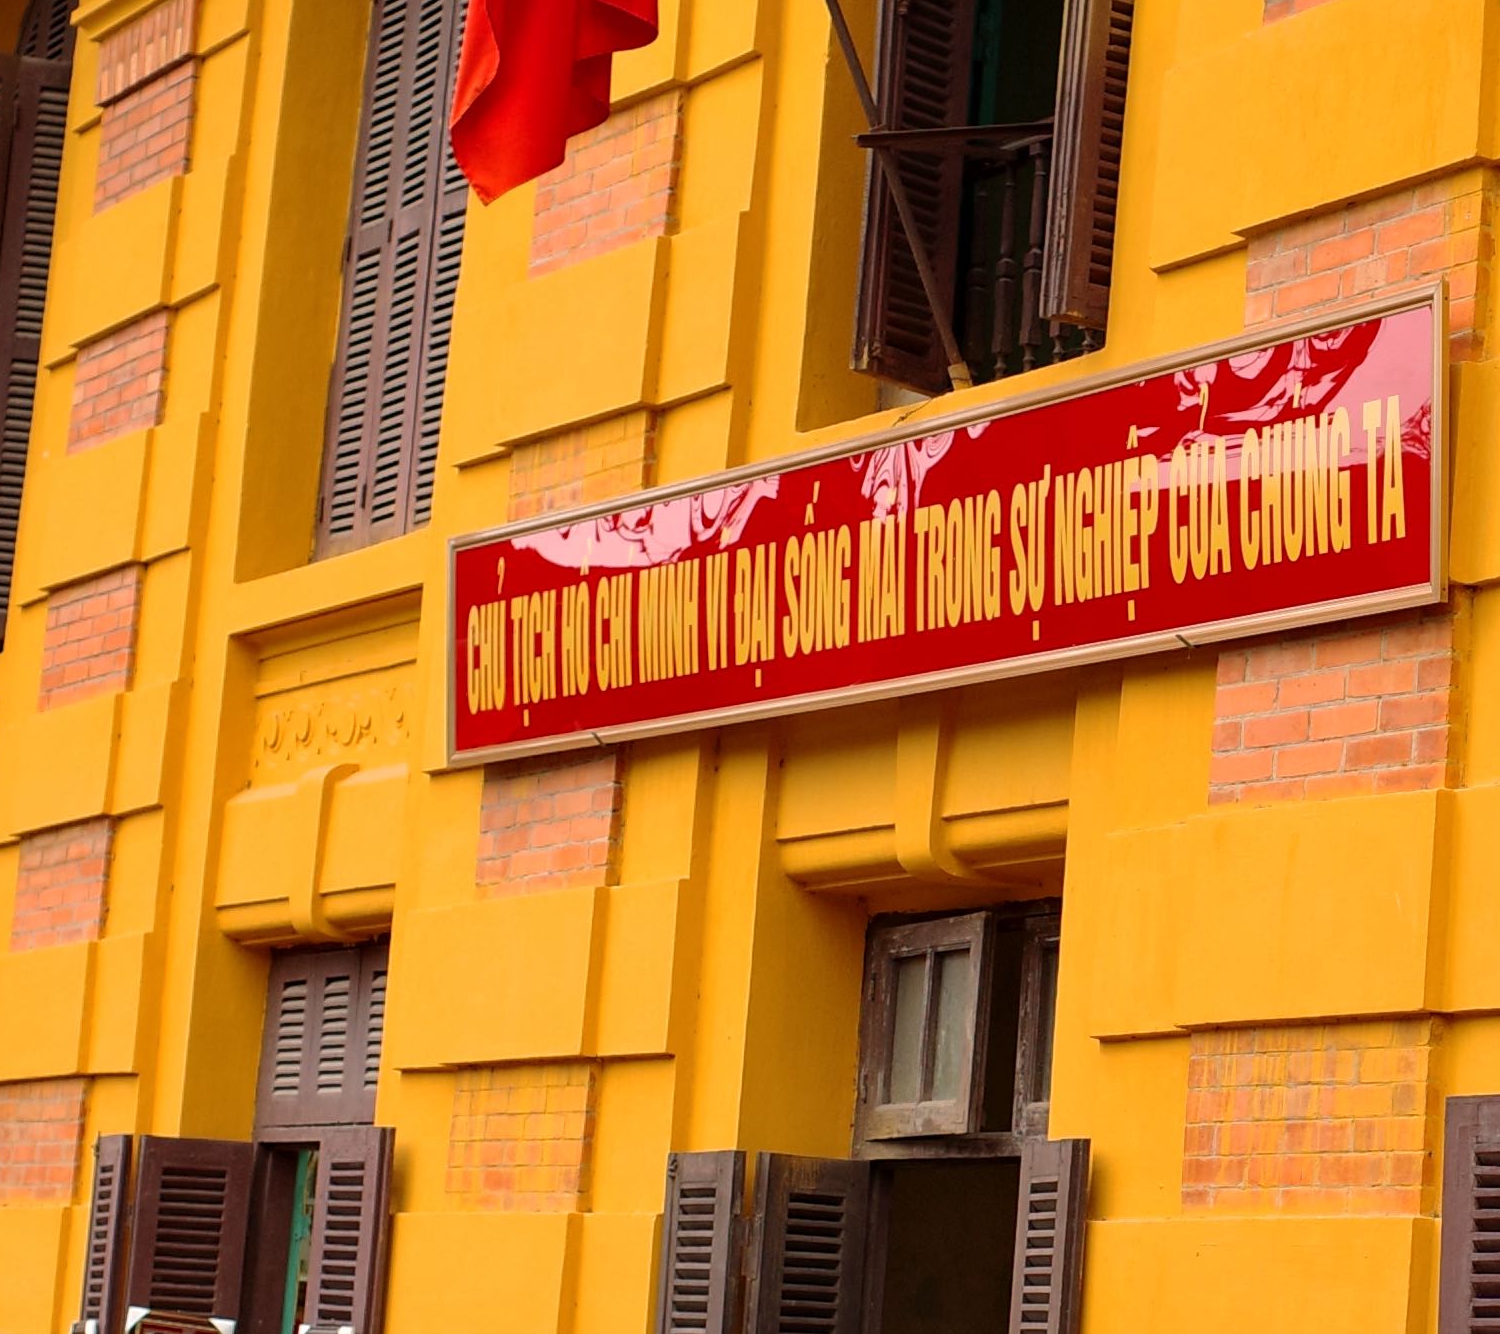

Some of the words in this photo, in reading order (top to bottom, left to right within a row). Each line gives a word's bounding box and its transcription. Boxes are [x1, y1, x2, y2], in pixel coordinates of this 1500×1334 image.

[467, 556, 506, 715] CHỦ
[510, 589, 557, 727] TỊCH
[561, 537, 592, 698] HỒ
[595, 544, 635, 692] CHÍ
[638, 558, 700, 684] MINH
[733, 541, 777, 688] ĐẠI
[782, 480, 851, 658] SỐNG
[914, 489, 1001, 632] TRONG
[1009, 464, 1051, 641] SỰ
[1054, 425, 1159, 622] NGHIỆP
[1169, 382, 1232, 585] CỦA
[1240, 382, 1351, 571] CHÚNG
[1363, 394, 1406, 545] TA
